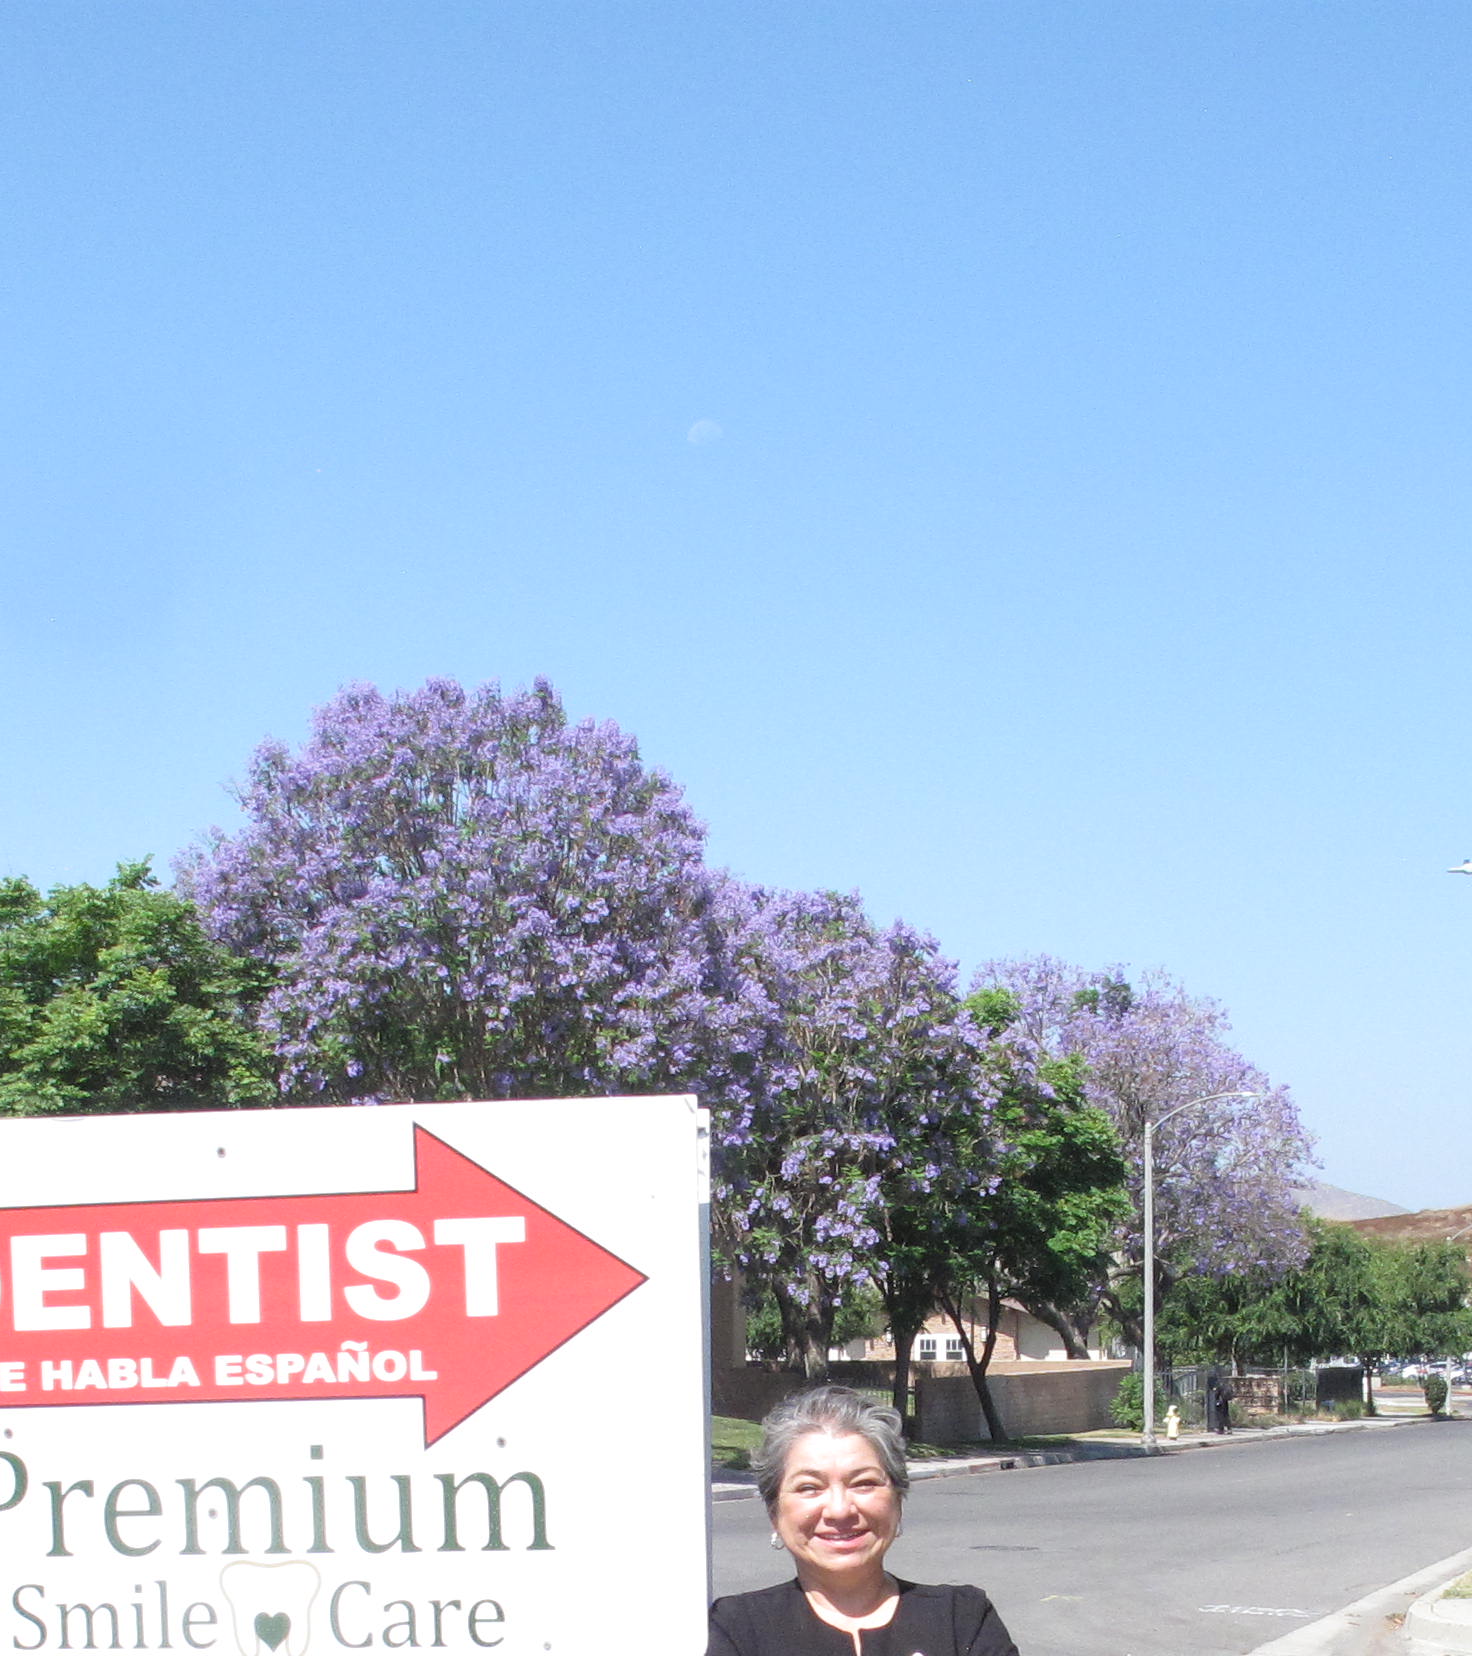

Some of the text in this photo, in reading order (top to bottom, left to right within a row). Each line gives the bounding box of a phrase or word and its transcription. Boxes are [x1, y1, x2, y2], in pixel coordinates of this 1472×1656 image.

[41, 1356, 201, 1391] HABLA
[214, 1341, 438, 1386] ESPAÑOL
[13, 1582, 506, 1650] Smile Care
